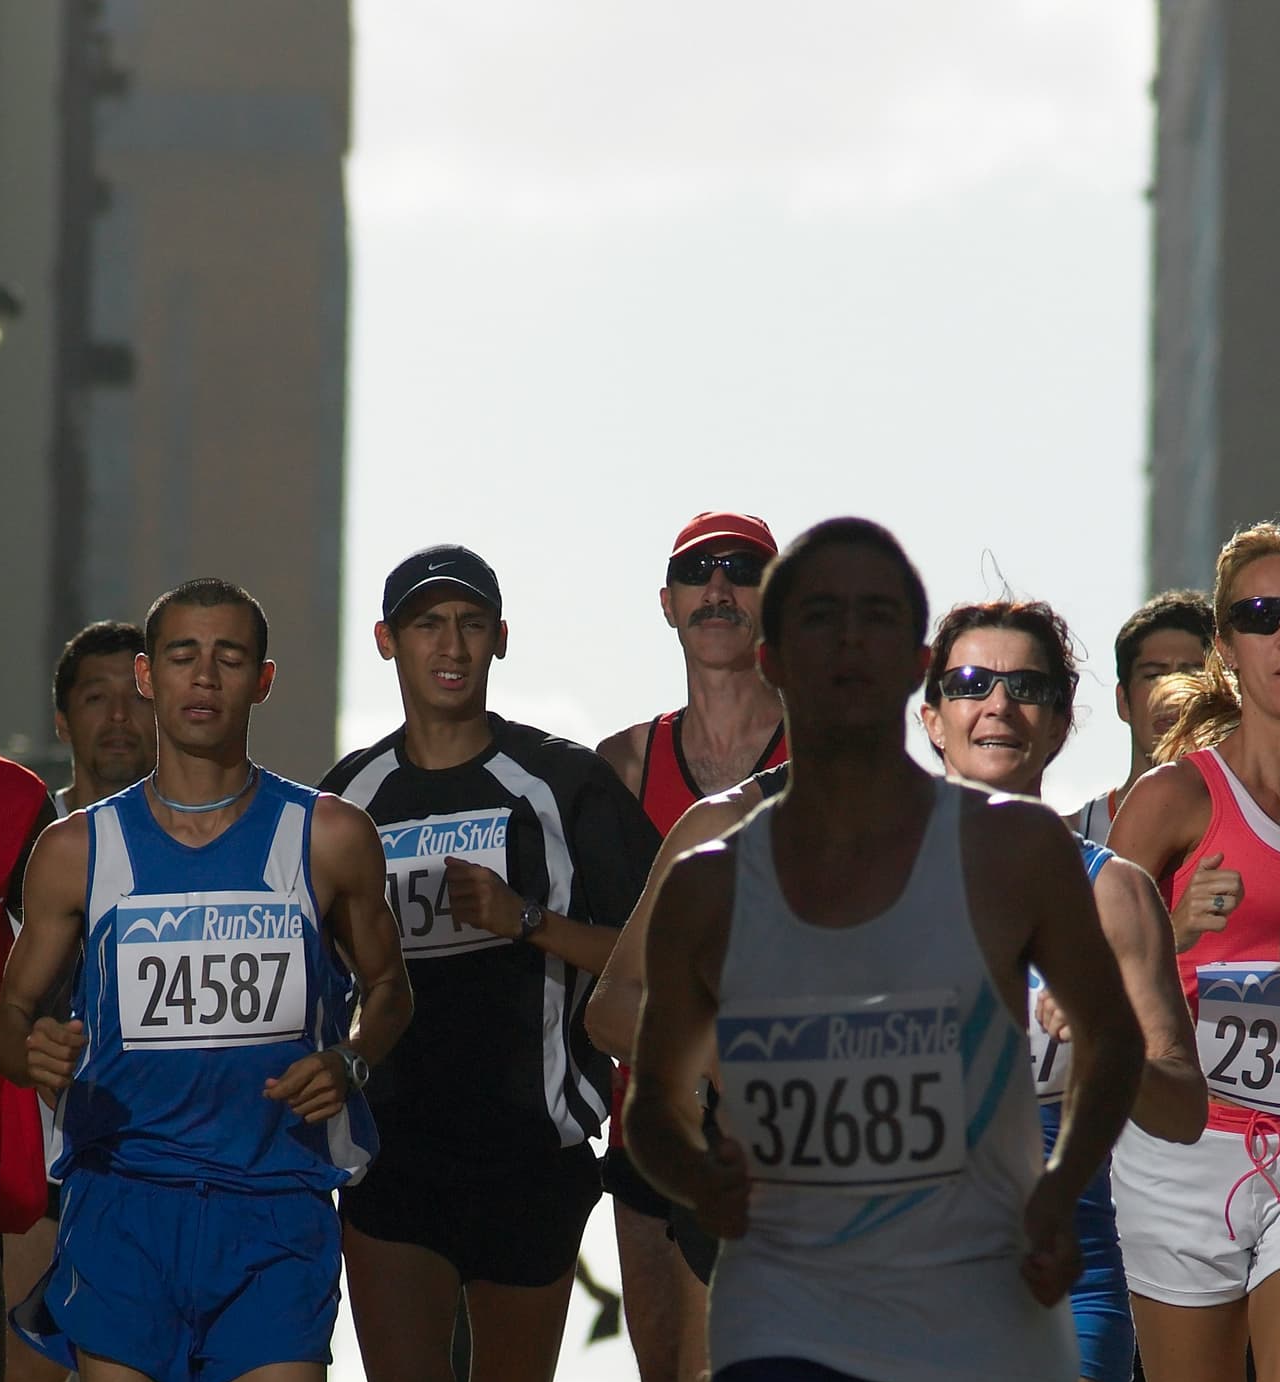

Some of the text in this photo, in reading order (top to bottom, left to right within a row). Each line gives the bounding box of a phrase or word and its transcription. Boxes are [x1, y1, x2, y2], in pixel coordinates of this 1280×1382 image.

[416, 818, 506, 857] RunStyle
[202, 904, 303, 940] RunStyle
[137, 952, 291, 1027] 24587
[826, 1008, 962, 1059] RunStyle
[745, 1072, 946, 1167] 32685
